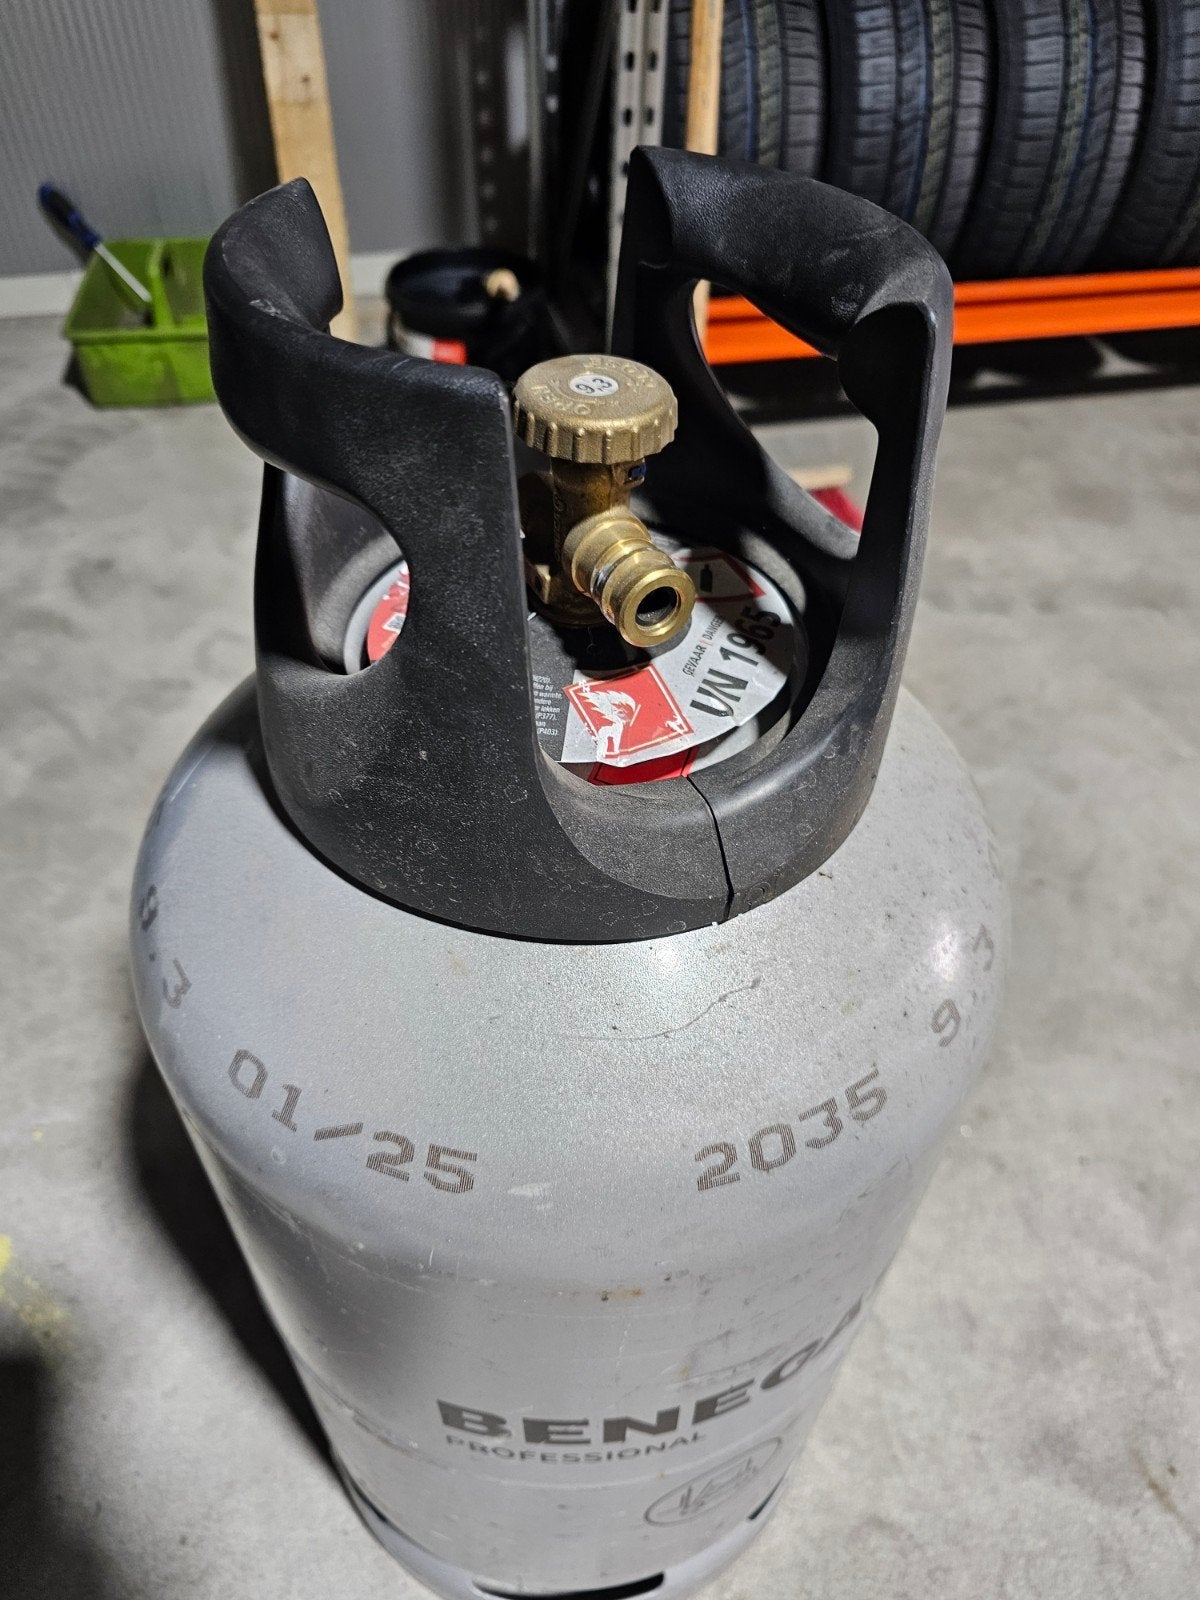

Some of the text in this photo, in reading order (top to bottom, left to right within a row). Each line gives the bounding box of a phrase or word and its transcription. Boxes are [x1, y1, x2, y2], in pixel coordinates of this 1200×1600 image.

[682, 645, 707, 677] GEVAAR
[690, 606, 782, 717] UN 1965
[228, 1049, 477, 1193] 01/25
[695, 1066, 888, 1191] 2035
[446, 1431, 706, 1464] PROFESSIONAL
